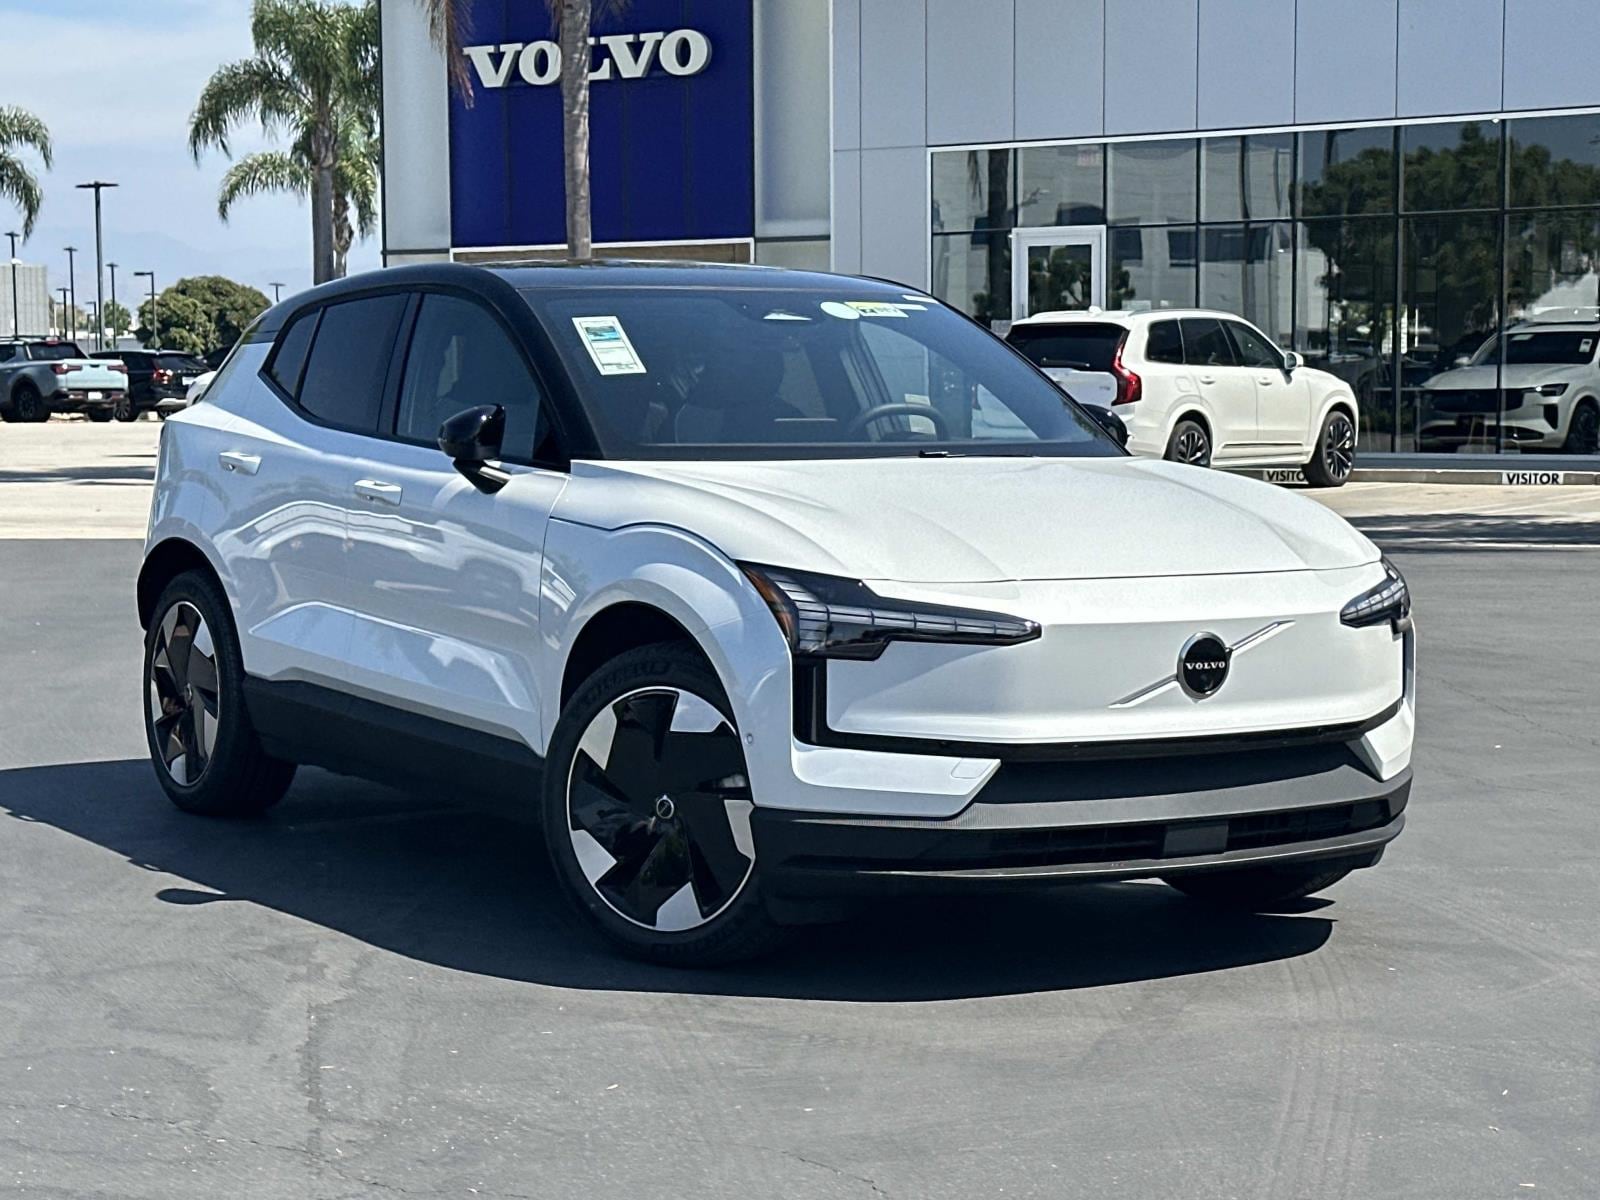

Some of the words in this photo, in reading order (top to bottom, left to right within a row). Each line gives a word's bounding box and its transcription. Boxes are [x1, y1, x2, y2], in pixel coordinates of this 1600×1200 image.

[1266, 470, 1306, 482] VISITO
[1506, 472, 1560, 485] VISITOR
[1185, 661, 1226, 670] VOLVO
